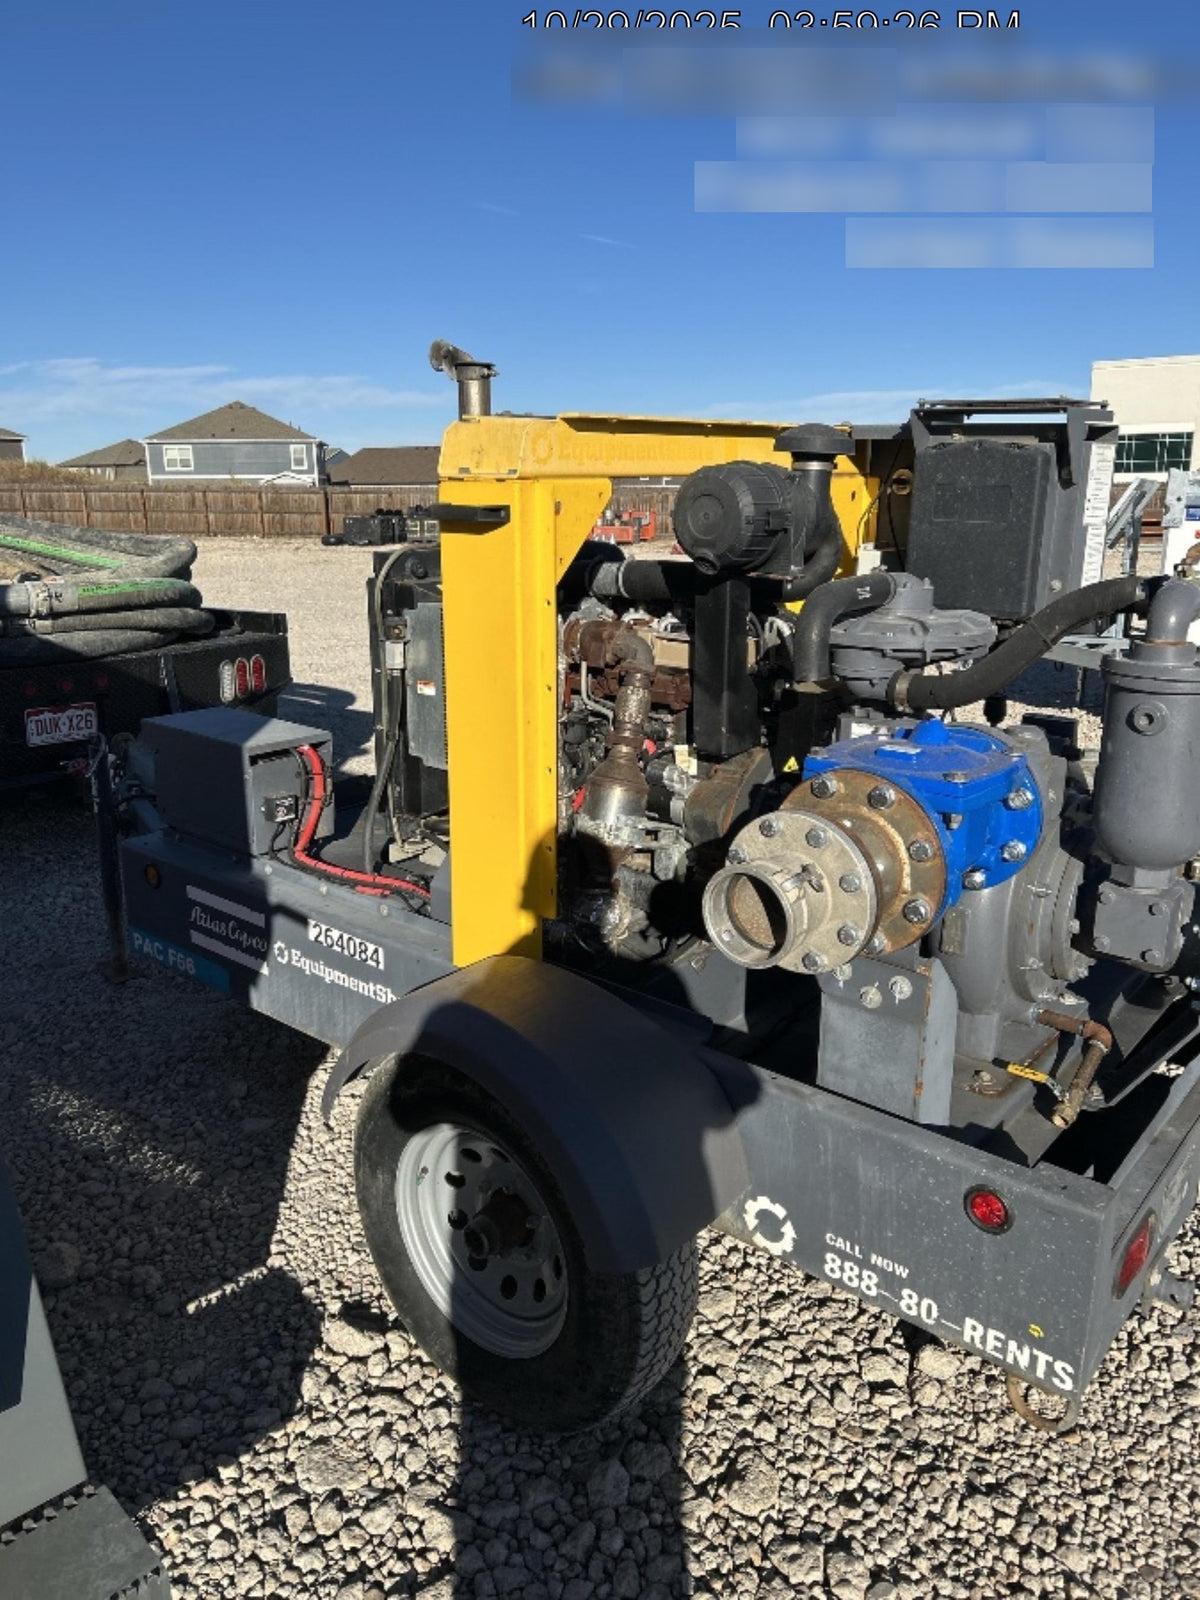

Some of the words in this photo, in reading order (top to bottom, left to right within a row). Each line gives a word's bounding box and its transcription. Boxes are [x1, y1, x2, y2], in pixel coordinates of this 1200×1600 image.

[132, 931, 164, 961] PAC
[312, 923, 381, 967] 264084
[291, 949, 398, 1005] EquipmentSh
[826, 1232, 863, 1260] CALL
[870, 1253, 910, 1279] NOW
